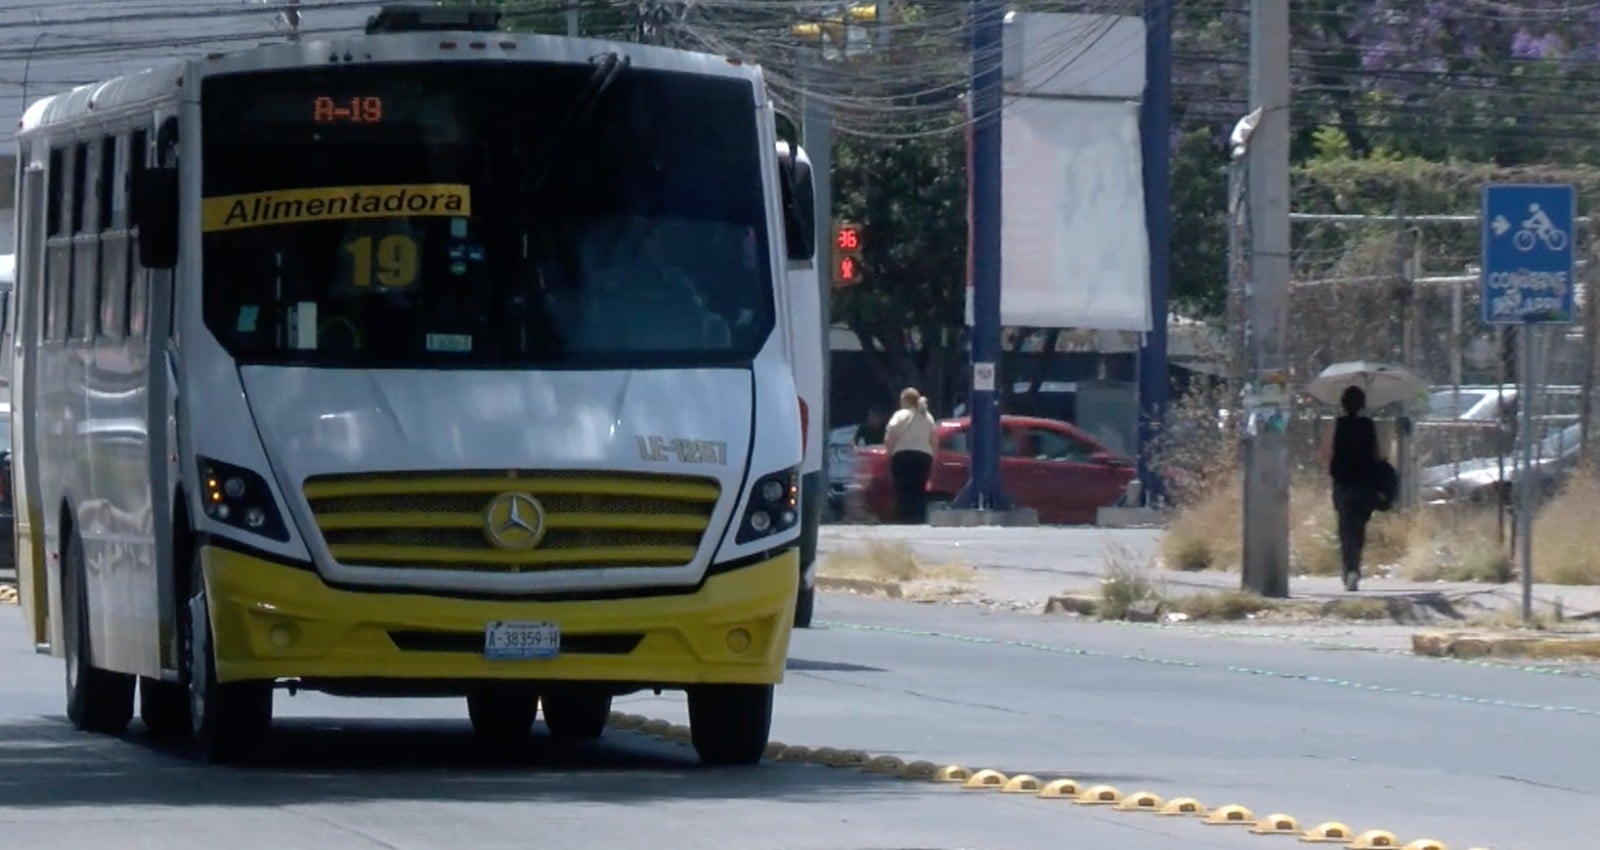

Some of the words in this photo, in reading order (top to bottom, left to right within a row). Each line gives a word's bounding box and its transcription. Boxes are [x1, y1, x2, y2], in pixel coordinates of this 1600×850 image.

[314, 96, 382, 121] A-19
[224, 189, 463, 225] Alimentadora
[346, 234, 418, 287] 19
